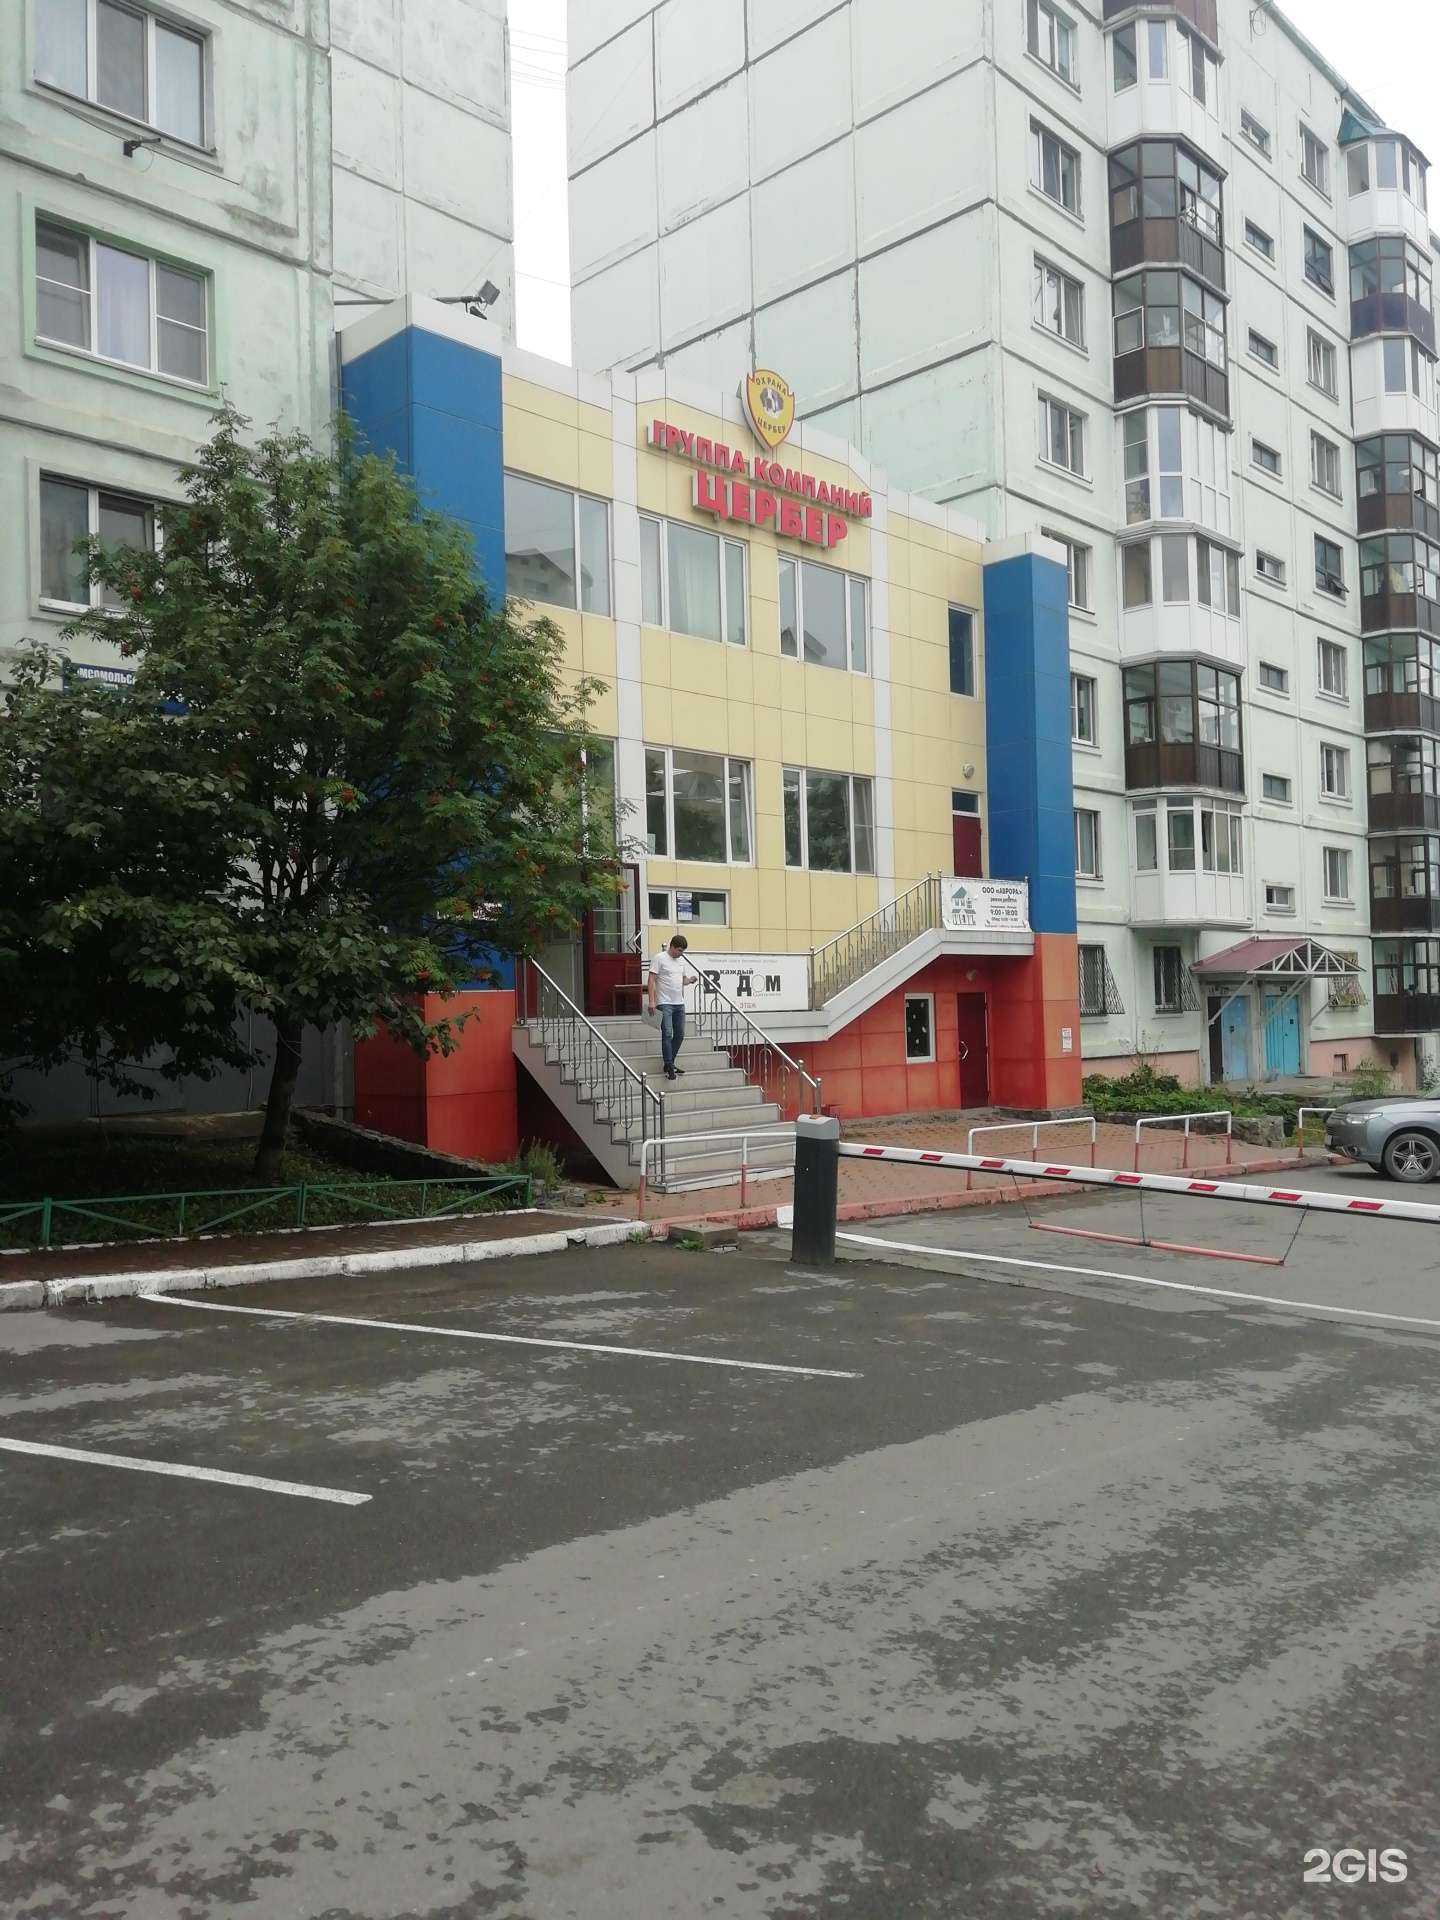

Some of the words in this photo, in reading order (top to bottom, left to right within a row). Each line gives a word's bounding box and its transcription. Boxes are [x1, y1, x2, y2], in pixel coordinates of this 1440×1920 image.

[756, 376, 787, 395] ОХРАНА
[757, 417, 786, 434] ЦЕРБЕР
[650, 419, 746, 475] ГРУППА
[753, 456, 873, 518] КОМПАНИЙ
[694, 469, 848, 549] ЦЕРБЕР
[982, 886, 995, 894] ООО
[703, 969, 721, 994] В
[720, 968, 753, 976] каждый
